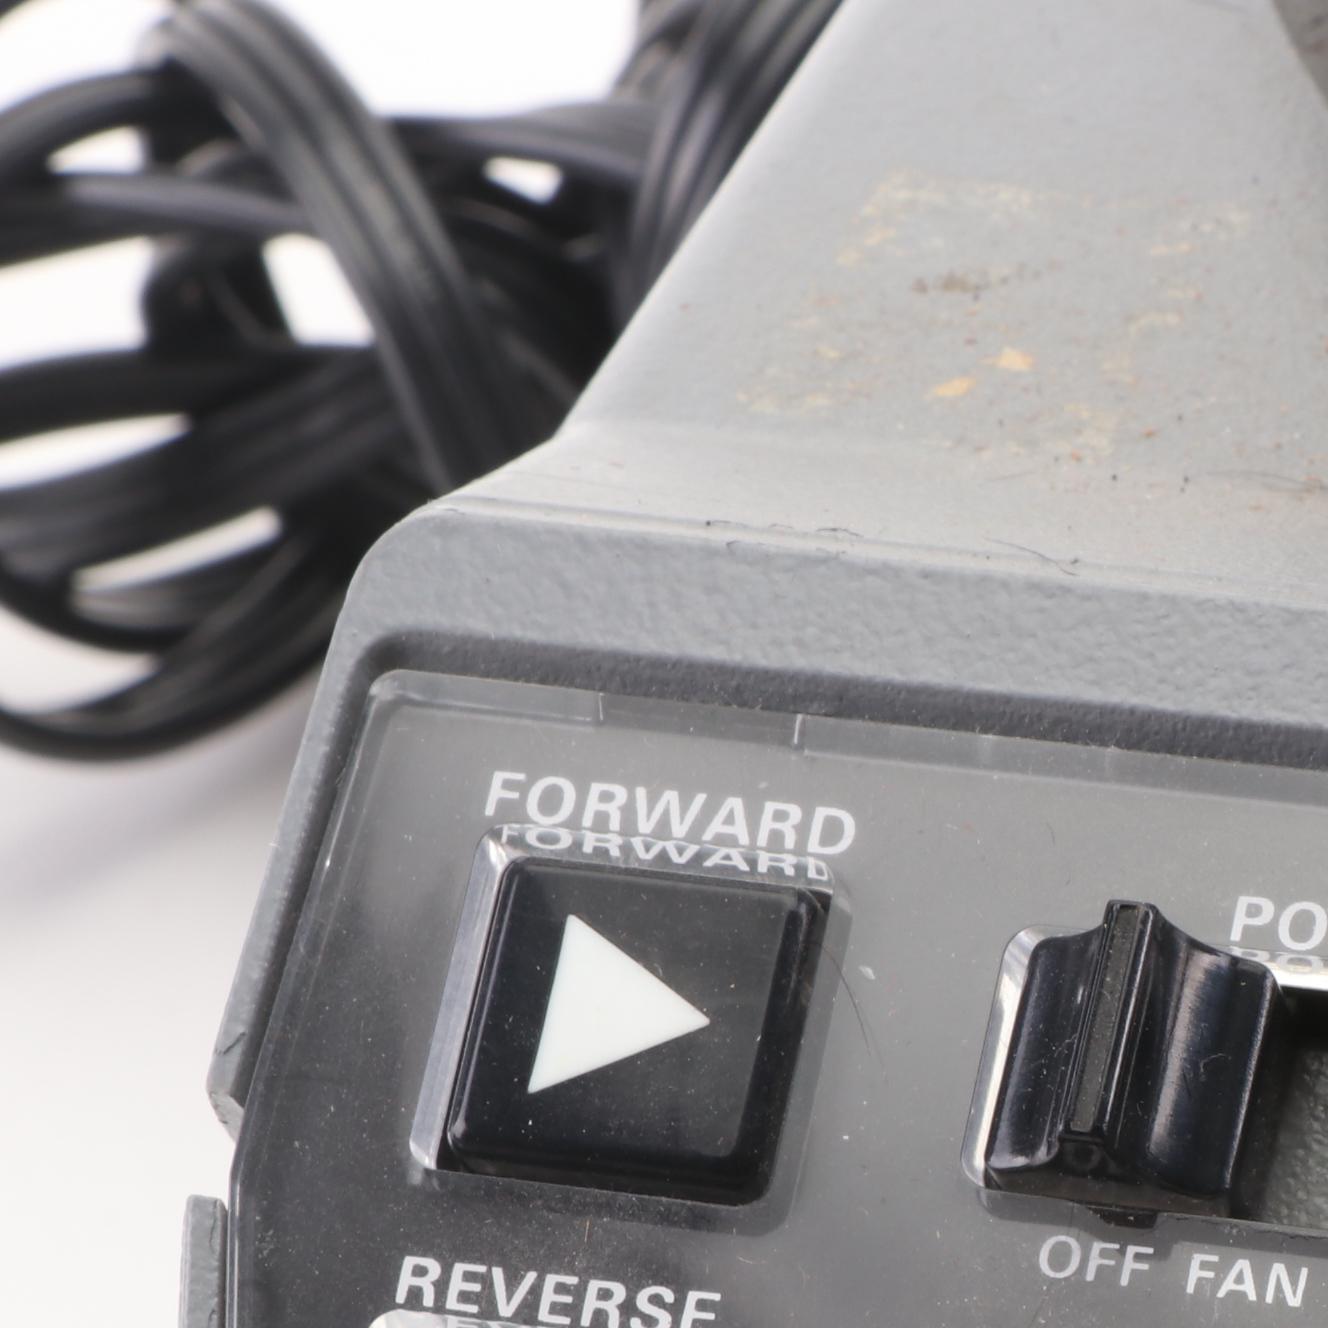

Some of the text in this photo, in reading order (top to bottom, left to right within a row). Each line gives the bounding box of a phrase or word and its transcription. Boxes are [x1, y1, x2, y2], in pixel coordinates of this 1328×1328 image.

[485, 771, 856, 855] FORWARD
[1038, 1236, 1154, 1286] OFF
[1186, 1254, 1308, 1307] FAN
